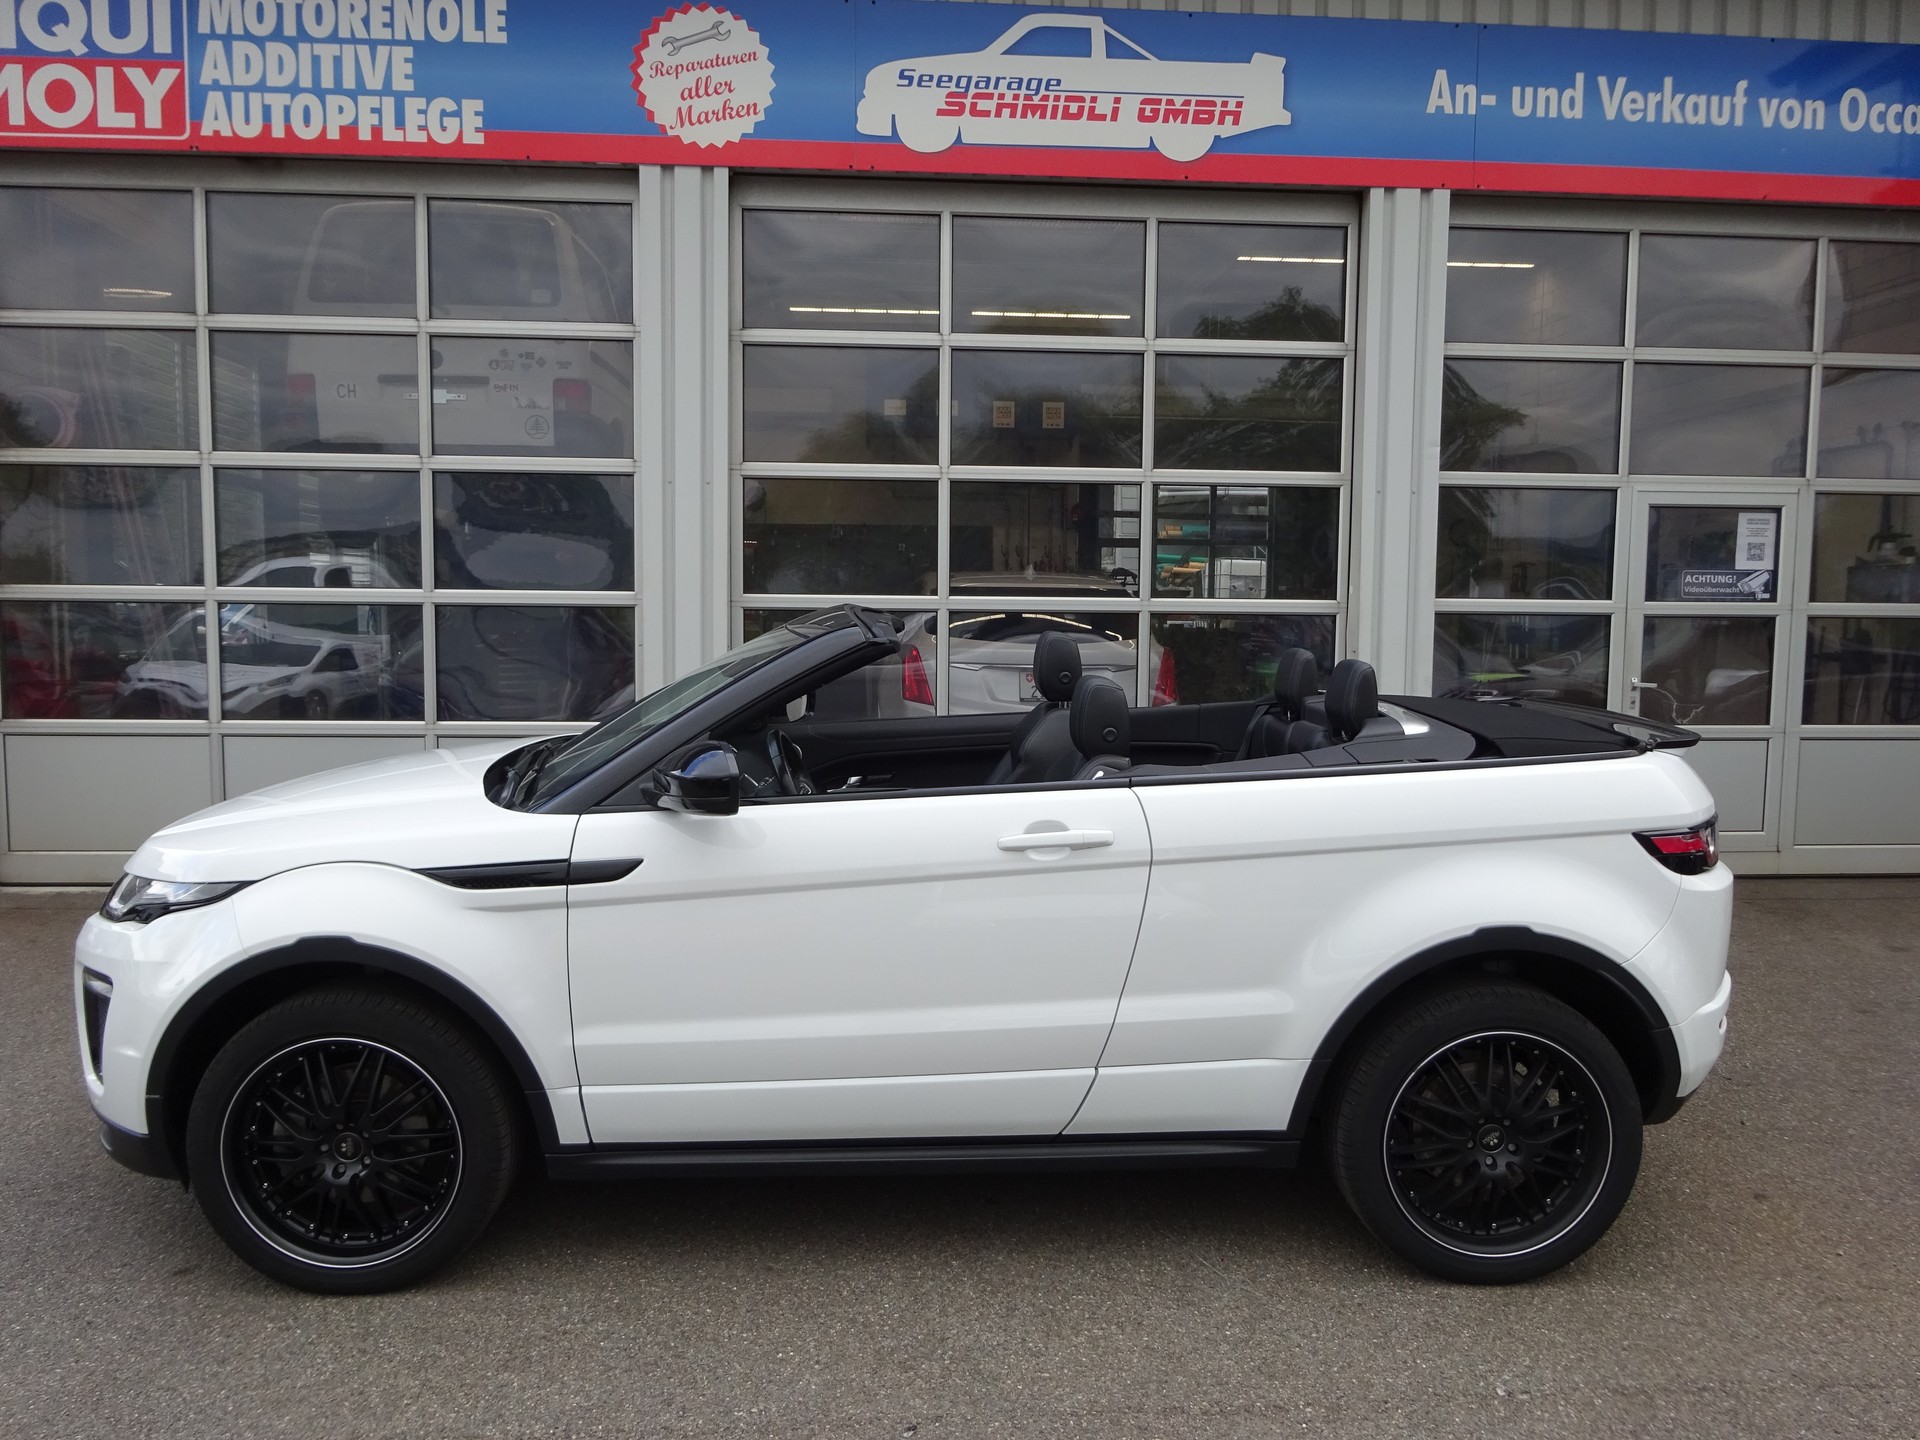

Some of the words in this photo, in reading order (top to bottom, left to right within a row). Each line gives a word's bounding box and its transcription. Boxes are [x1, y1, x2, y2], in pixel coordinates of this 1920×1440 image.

[200, 40, 414, 91] ADDITIVE
[650, 51, 759, 79] Reparaturen
[680, 75, 735, 101] aller
[897, 69, 1062, 96] Seegarage
[669, 98, 760, 130] Marken
[936, 91, 1122, 122] SCHMIDLI
[1136, 97, 1244, 126] GMBH
[1426, 69, 1496, 115] An-
[1512, 72, 1584, 119] und
[1597, 76, 1748, 126] Verkauf
[1759, 97, 1825, 130] von
[200, 91, 485, 144] AUTOPFLEGE
[336, 383, 357, 399] CH
[1684, 574, 1737, 584] ACHTUNG!
